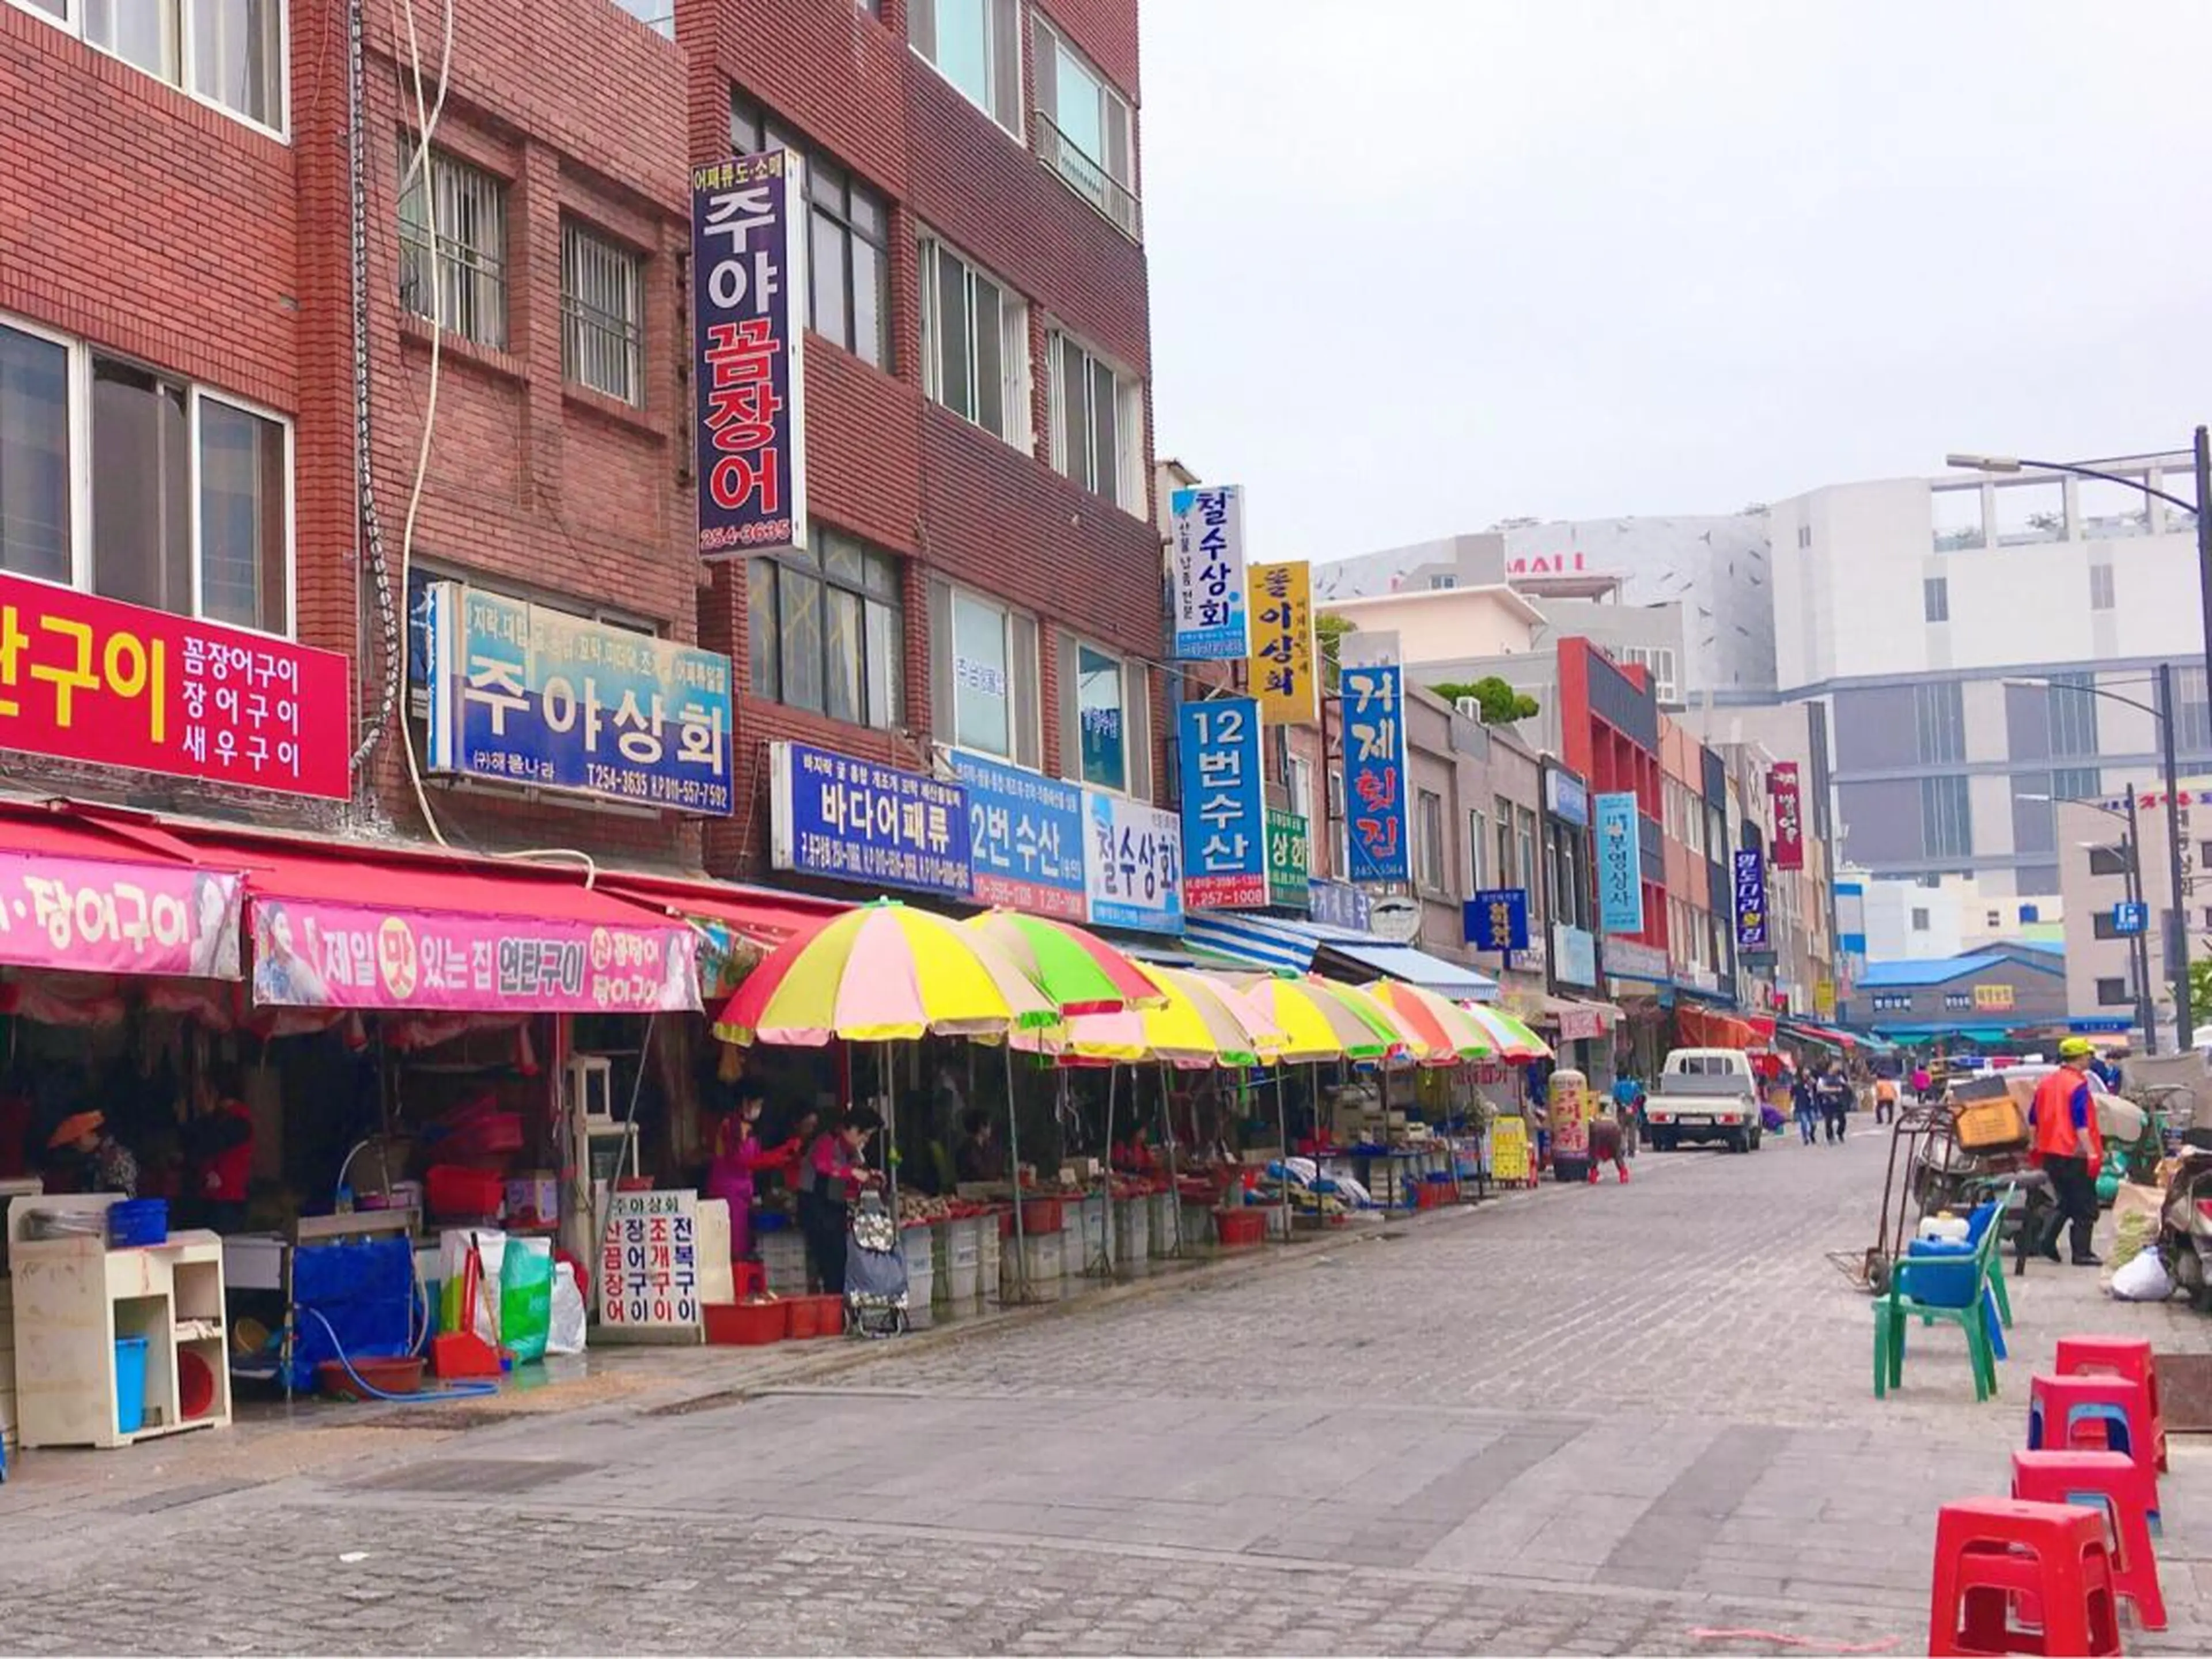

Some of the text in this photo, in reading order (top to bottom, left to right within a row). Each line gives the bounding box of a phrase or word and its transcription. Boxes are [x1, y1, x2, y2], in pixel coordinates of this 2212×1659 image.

[1196, 492, 1232, 627] 철수상회
[182, 636, 298, 695] 꼼장어구이
[183, 680, 298, 736] 장어구이
[183, 725, 298, 778] 새우구이
[464, 654, 724, 776] 주야상회
[821, 783, 949, 854] 바다어패류
[1192, 710, 1249, 872] 12번수산
[24, 874, 190, 954] 장어구이
[323, 930, 375, 987] 제일
[421, 937, 467, 990] 있는
[472, 939, 492, 991] 집
[498, 937, 585, 997] 연탄구이
[625, 1218, 648, 1323] 장어구이
[650, 1217, 672, 1323] 조개구이
[674, 1216, 696, 1323] 전복구이
